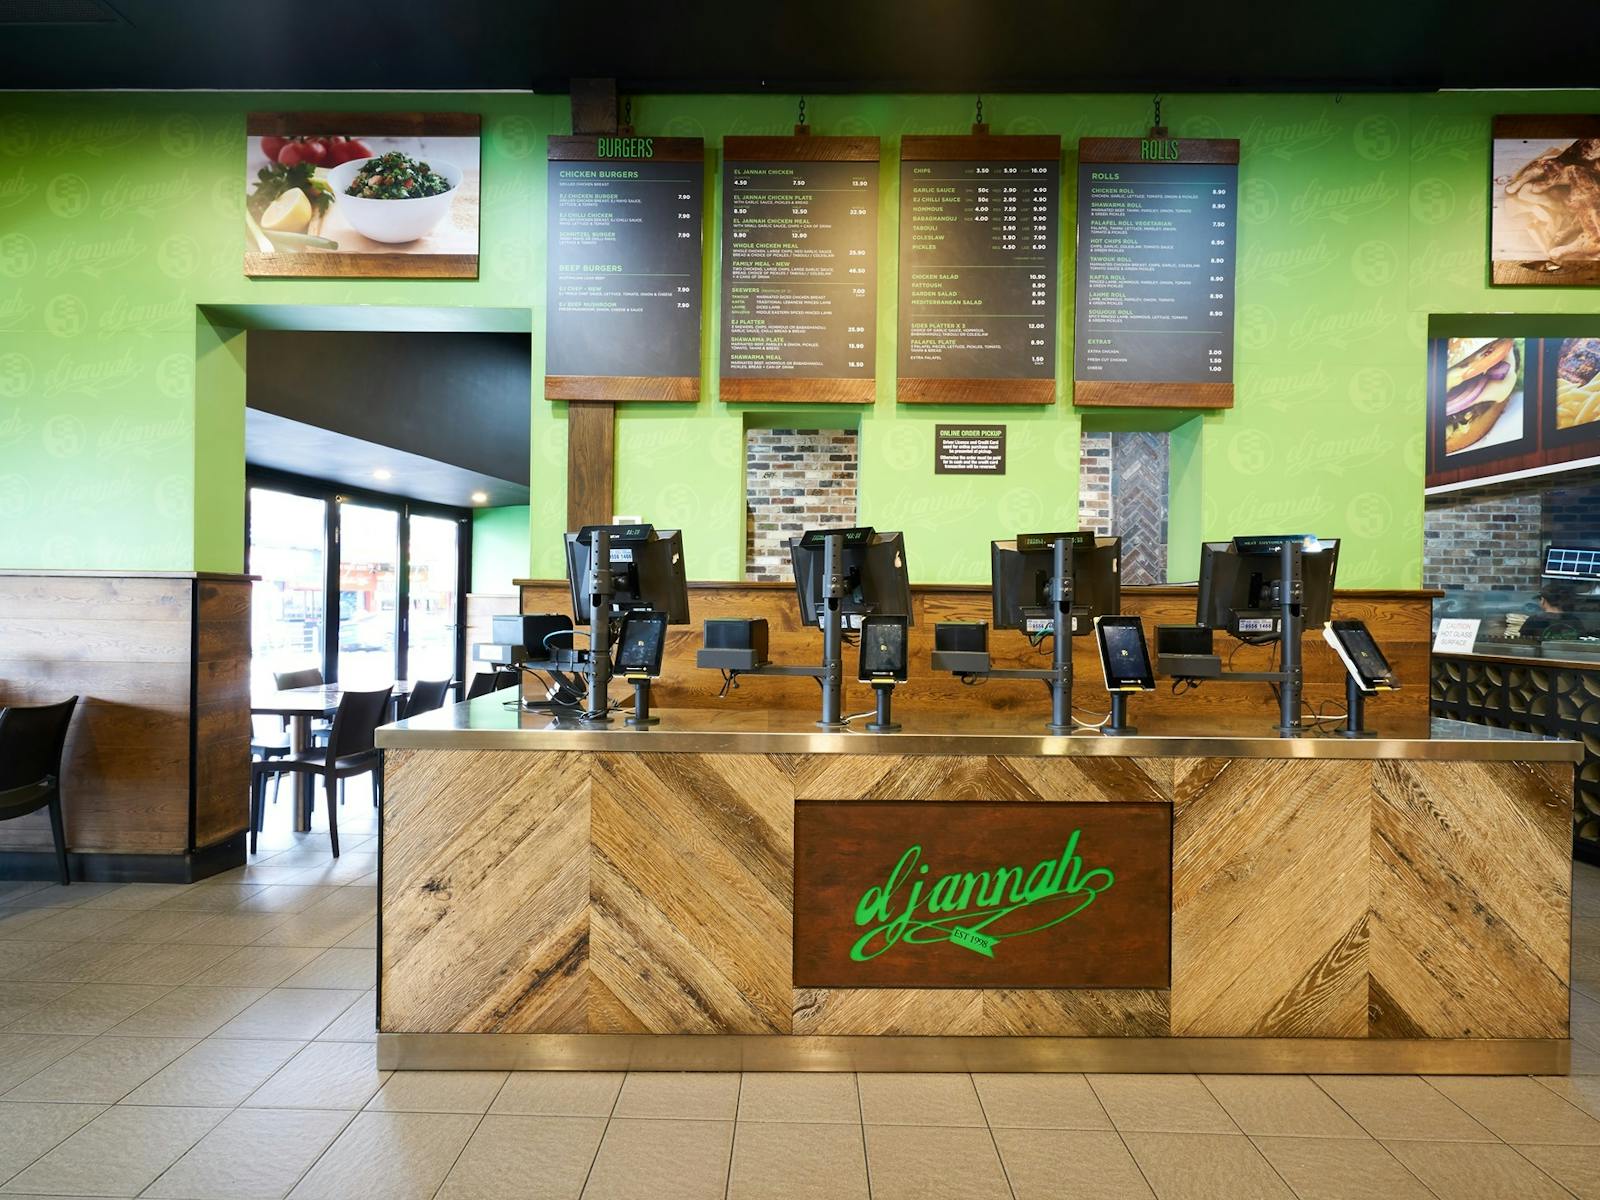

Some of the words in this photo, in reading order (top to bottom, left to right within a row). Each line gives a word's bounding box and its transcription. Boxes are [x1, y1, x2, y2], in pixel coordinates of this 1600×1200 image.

[598, 138, 653, 158] BURGERS
[1142, 140, 1178, 160] ROLLS
[954, 930, 968, 940] EST
[970, 935, 989, 948] 1998
